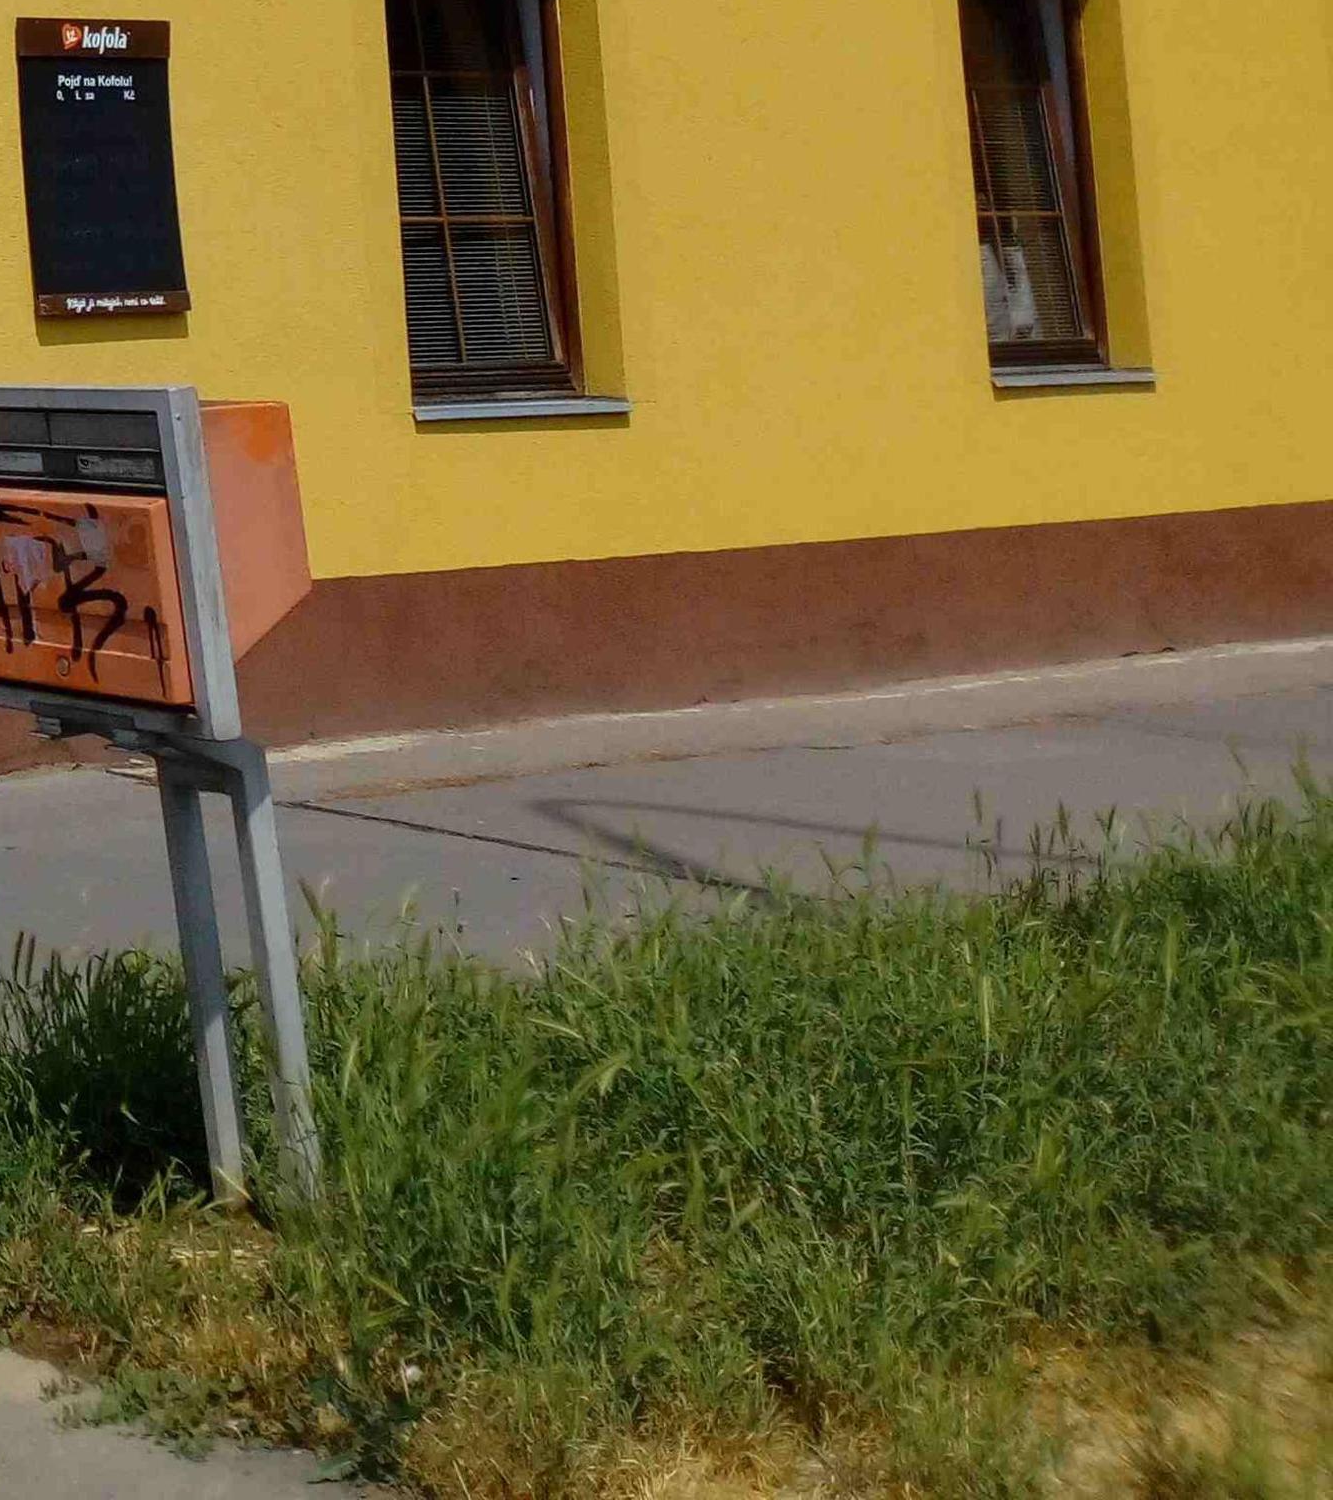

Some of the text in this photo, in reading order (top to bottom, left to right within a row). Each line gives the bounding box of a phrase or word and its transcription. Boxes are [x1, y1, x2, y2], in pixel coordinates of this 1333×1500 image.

[82, 25, 128, 55] kofola
[83, 77, 96, 87] na
[97, 74, 133, 87] Kofolu!
